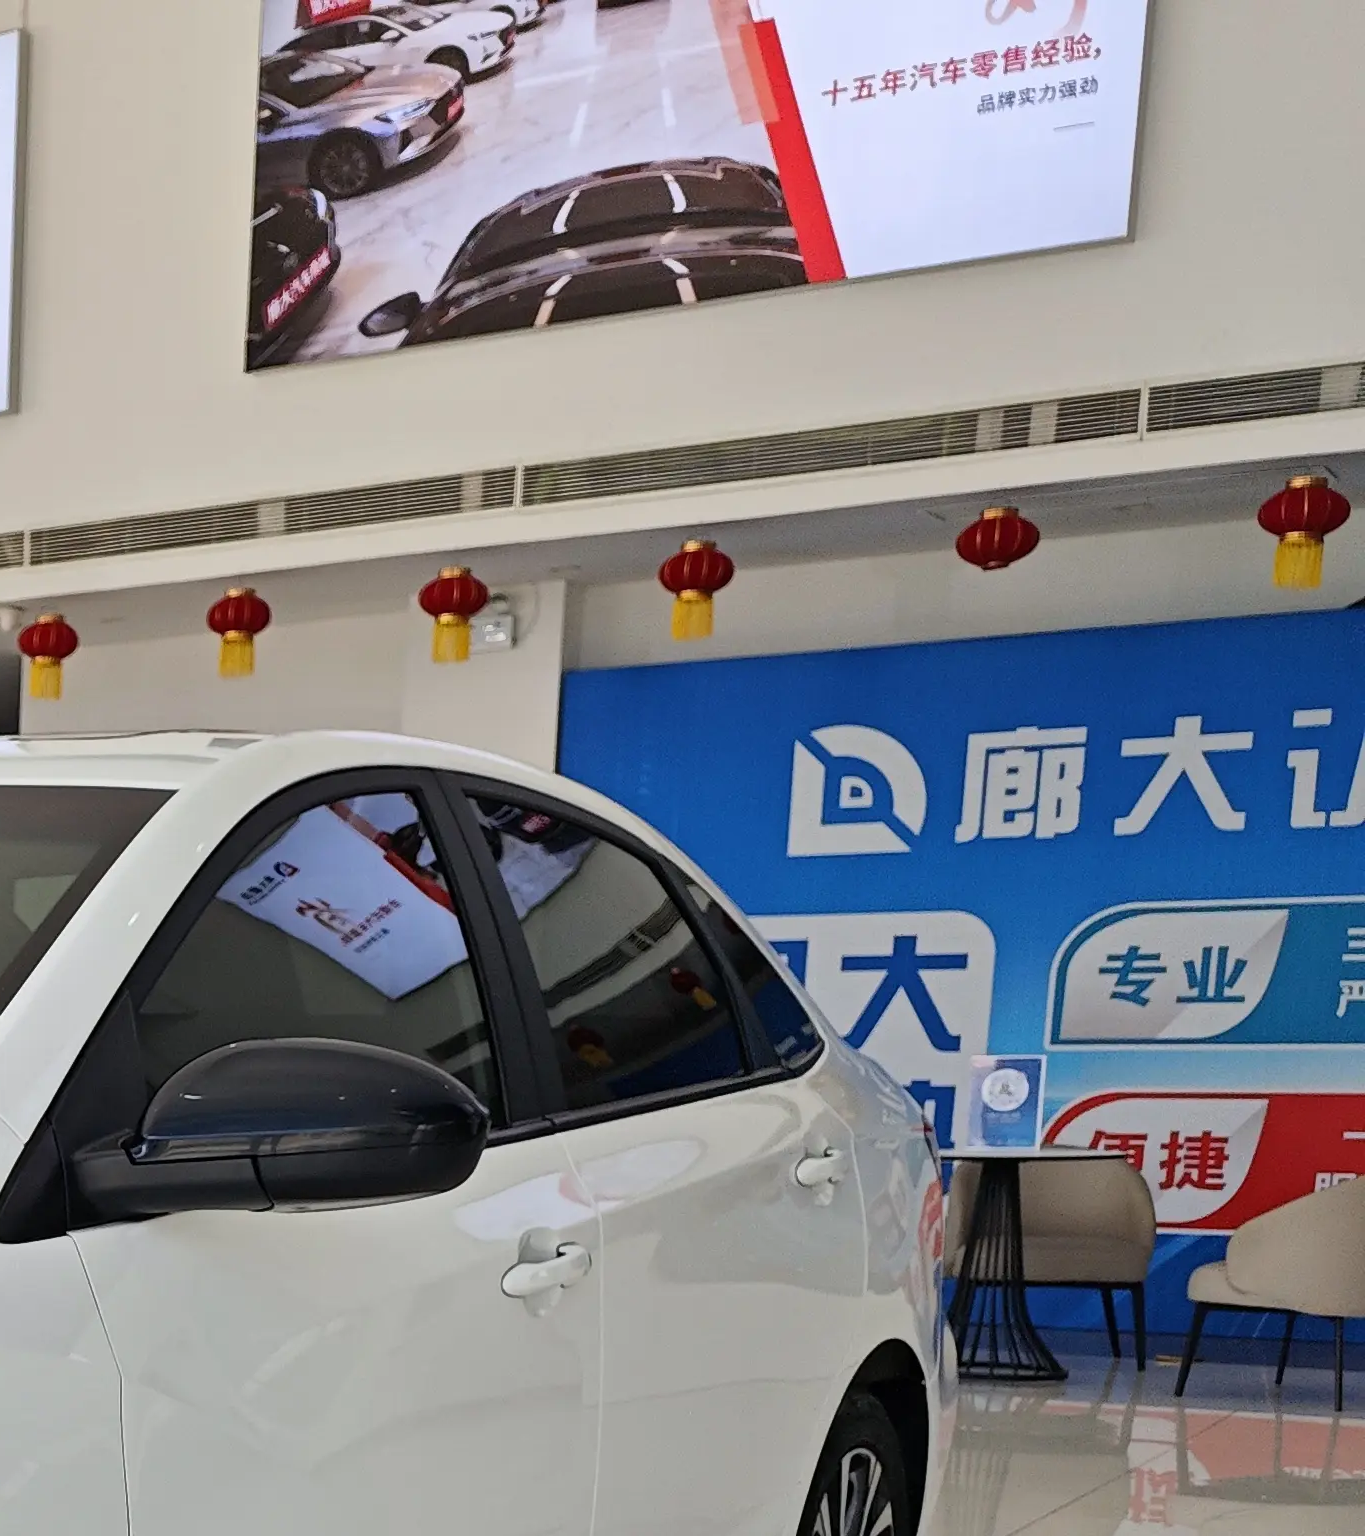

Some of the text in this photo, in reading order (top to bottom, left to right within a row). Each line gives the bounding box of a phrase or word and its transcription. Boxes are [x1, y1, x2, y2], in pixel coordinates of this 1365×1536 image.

[976, 75, 1100, 116] 品牌实力强劲
[769, 934, 969, 1051] 大
[1098, 944, 1249, 1007] 专业
